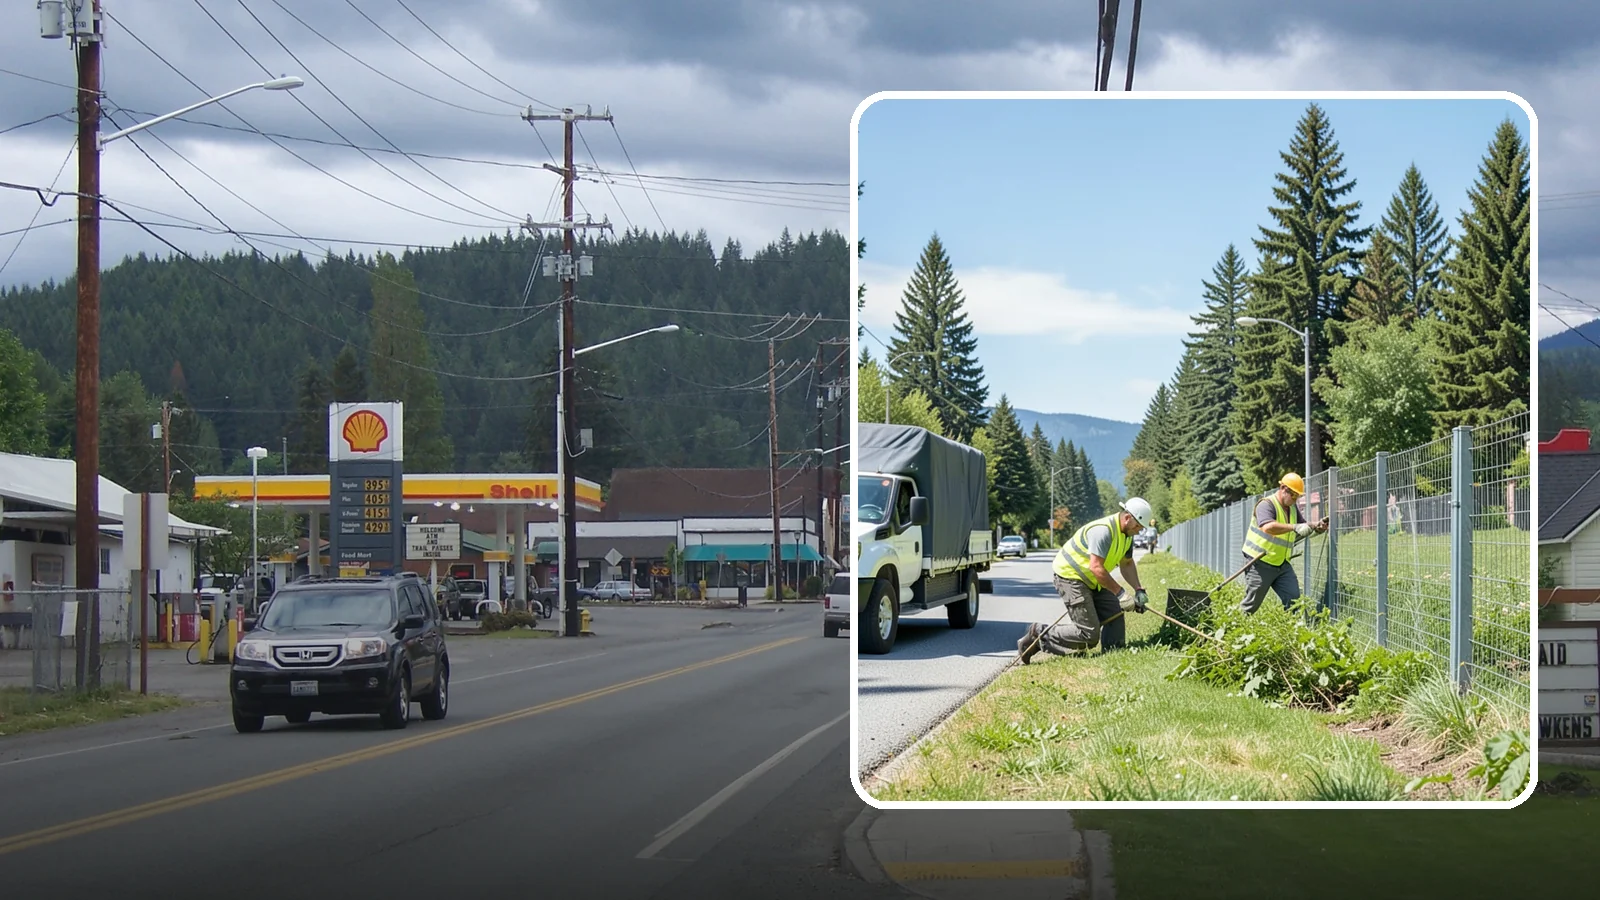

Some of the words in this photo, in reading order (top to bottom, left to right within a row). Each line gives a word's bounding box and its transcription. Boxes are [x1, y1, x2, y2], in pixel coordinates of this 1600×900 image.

[365, 480, 384, 490] 395
[490, 484, 548, 499] Shell
[365, 494, 384, 504] 405
[365, 507, 384, 518] 415
[365, 521, 384, 533] 429
